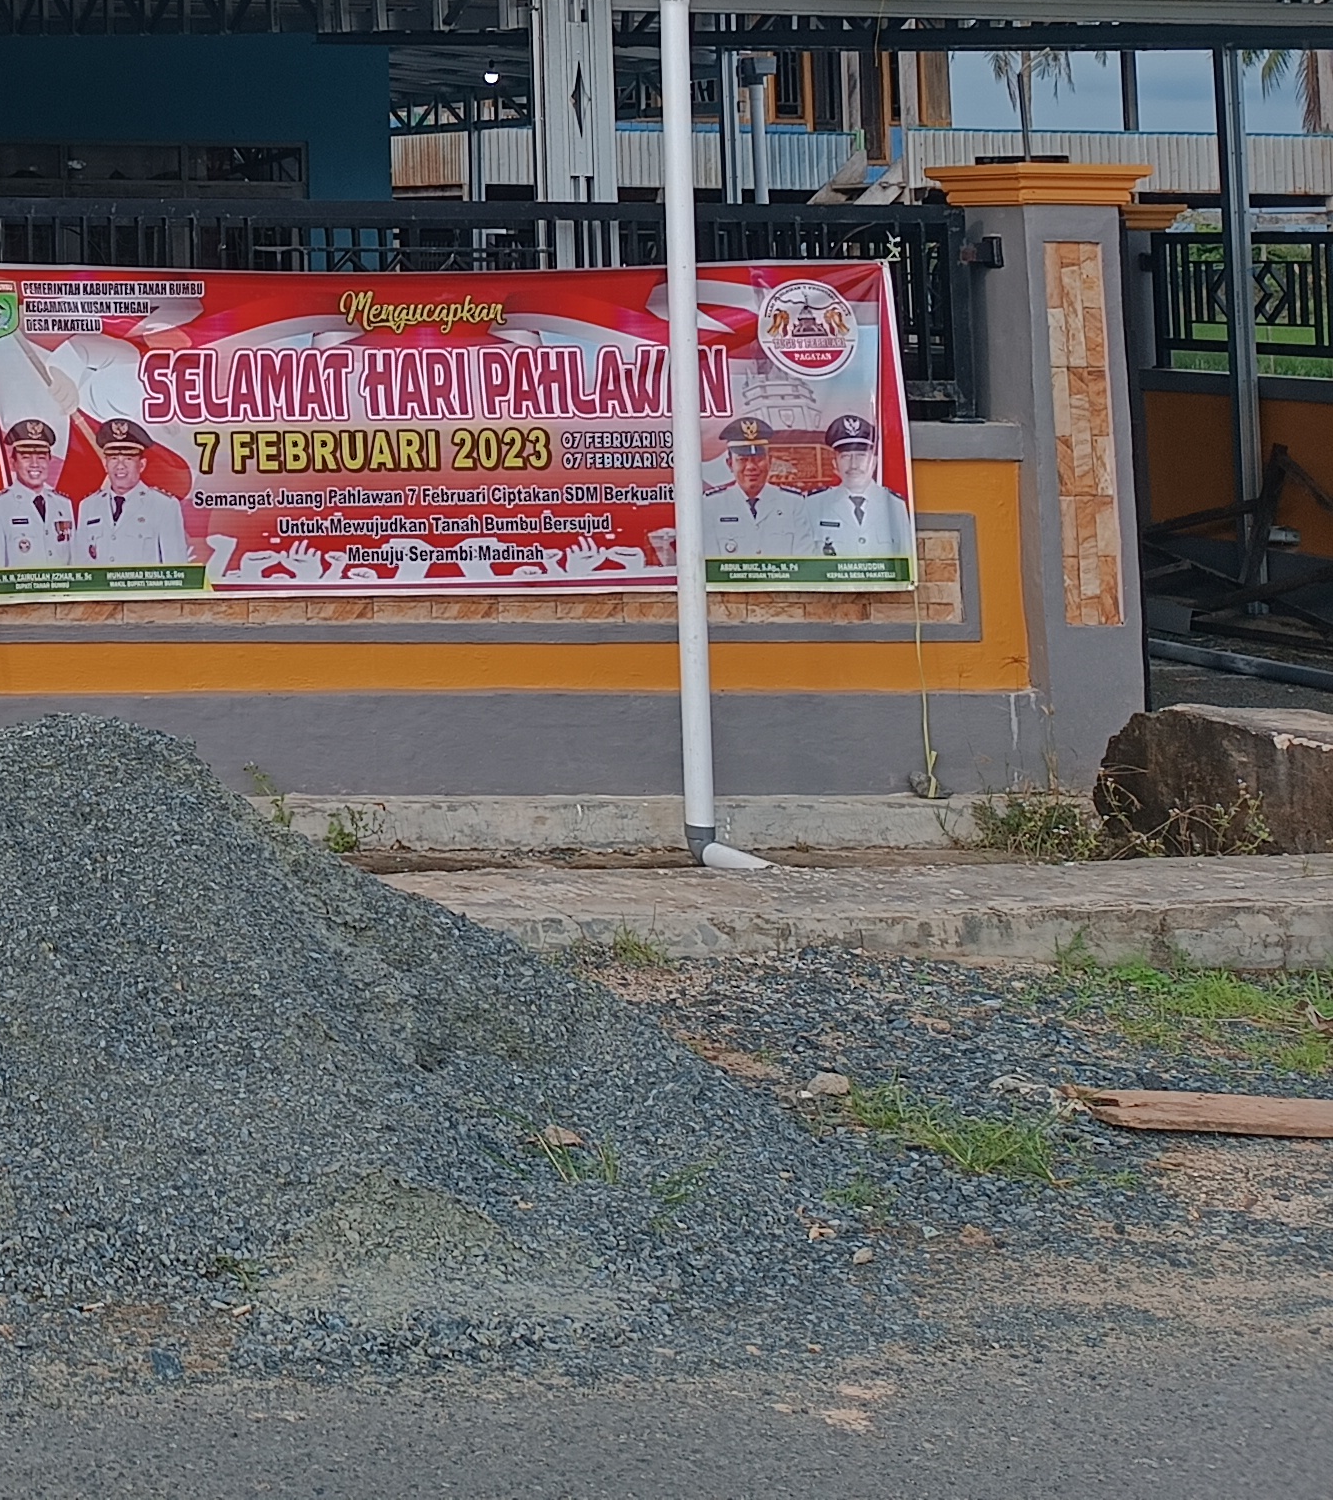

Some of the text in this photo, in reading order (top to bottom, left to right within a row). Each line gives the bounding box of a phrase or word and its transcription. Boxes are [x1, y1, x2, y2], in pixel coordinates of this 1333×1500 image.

[22, 282, 203, 296] PEMERINTAH KABUPATEN TANAH BUMBU
[24, 300, 150, 315] KECAMATAN KUSAN TENGAH
[339, 290, 507, 335] Mengucapkan
[25, 318, 102, 332] DESA PAKATELLU
[793, 353, 832, 361] PAGATAN
[138, 345, 734, 424] SELAMAT HARI PAHLAWN
[561, 431, 583, 450] 07
[584, 431, 657, 450] FEBRUARI
[193, 426, 552, 476] 7 FEBRUARI 2023
[562, 452, 583, 470] 07
[585, 452, 657, 470] FEBRUARI
[194, 485, 675, 509] Semangat Juang Pahlawan 7 Februari Ciptakan SDM Berkualit
[278, 513, 611, 539] Untuk Mewujudkan Tanah Bumbu Bersujud
[347, 543, 545, 566] Menuju Serambi Madinah
[837, 563, 885, 571] HAMARUDDIN
